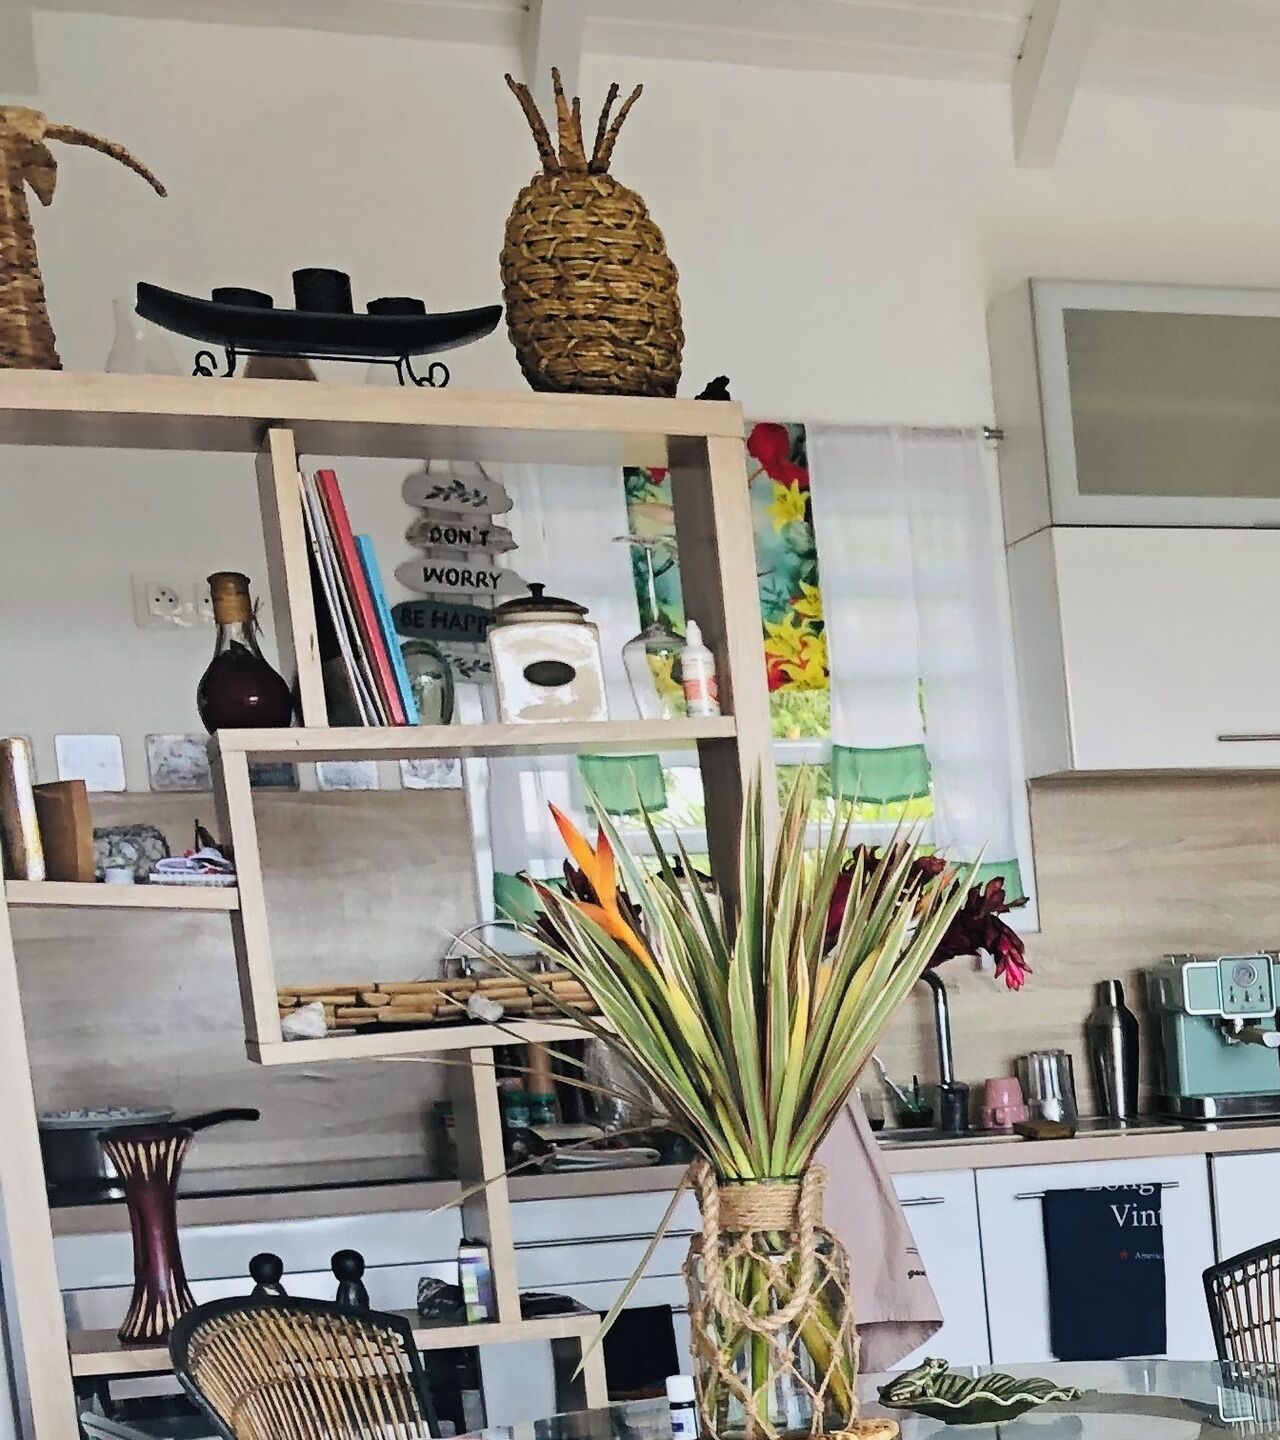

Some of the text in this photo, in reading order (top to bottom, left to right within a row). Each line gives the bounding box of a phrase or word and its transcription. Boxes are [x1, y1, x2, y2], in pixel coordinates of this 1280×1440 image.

[429, 525, 489, 546] DON'T
[423, 566, 502, 590] WORRY
[401, 607, 496, 634] BE HAPP
